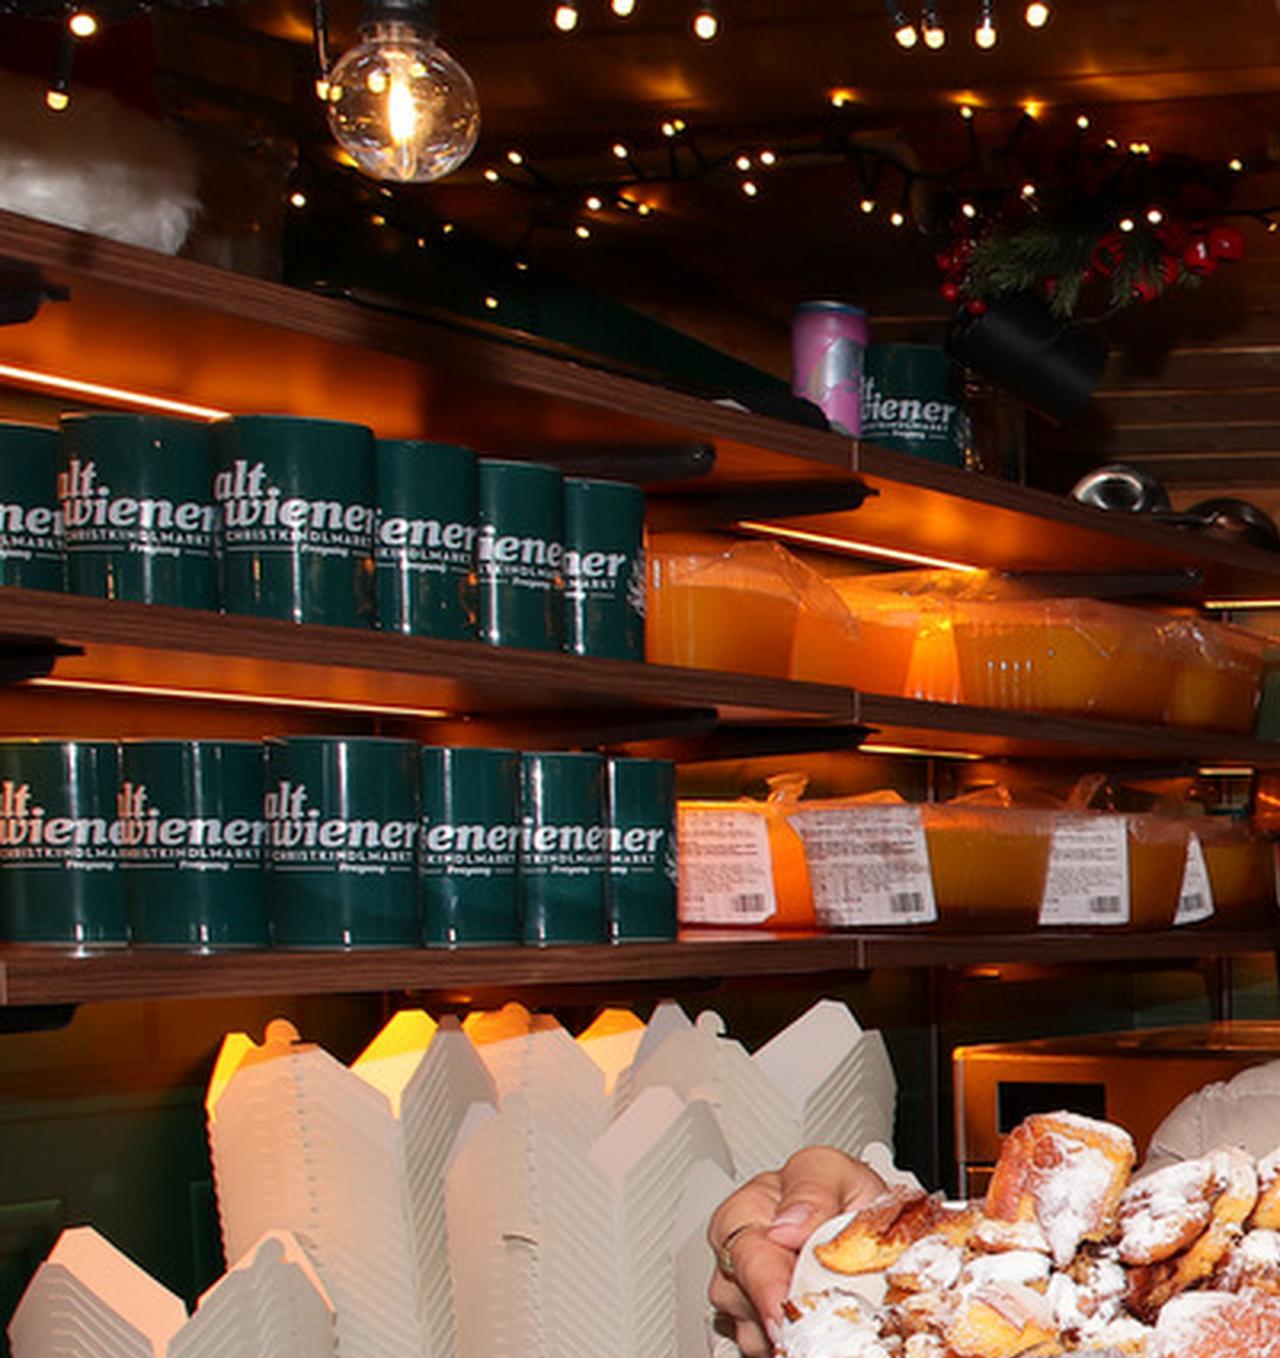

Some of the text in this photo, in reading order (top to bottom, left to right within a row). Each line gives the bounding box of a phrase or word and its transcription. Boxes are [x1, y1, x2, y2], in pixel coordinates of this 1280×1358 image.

[214, 459, 267, 500] alt
[63, 486, 220, 532] wiener
[224, 486, 373, 534] wiener
[264, 781, 308, 819] alt
[271, 808, 418, 849] wiener
